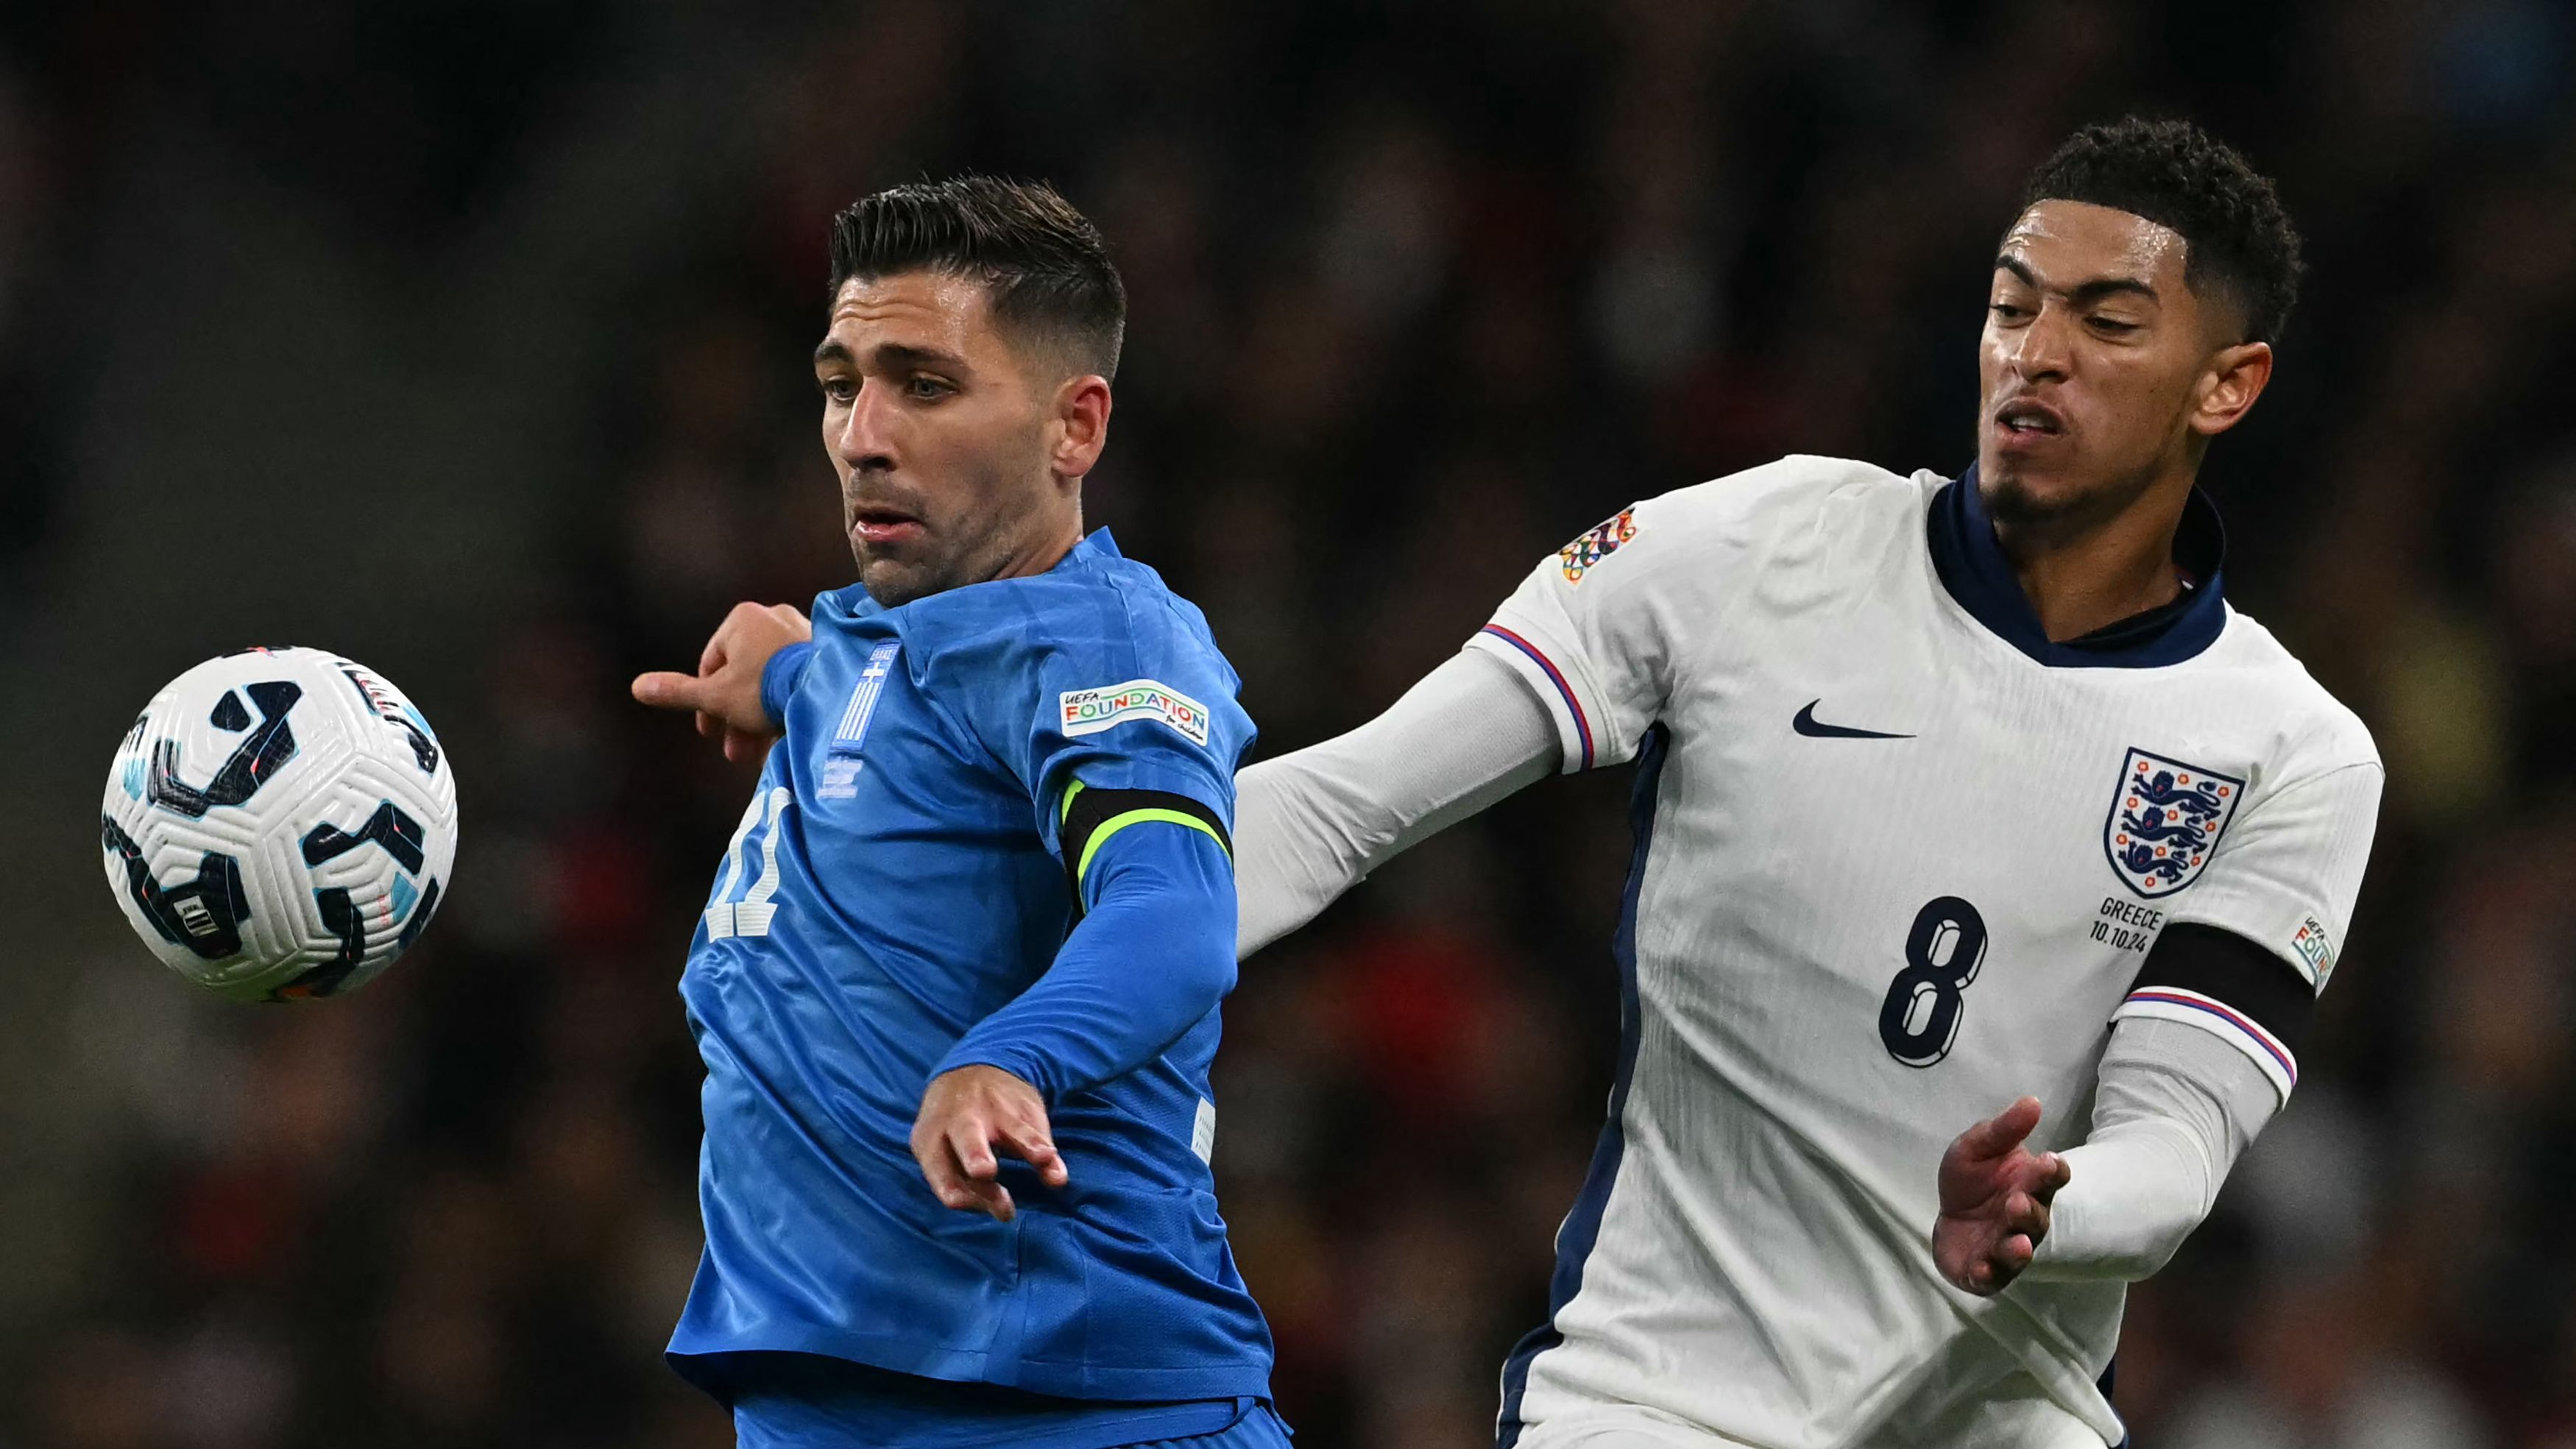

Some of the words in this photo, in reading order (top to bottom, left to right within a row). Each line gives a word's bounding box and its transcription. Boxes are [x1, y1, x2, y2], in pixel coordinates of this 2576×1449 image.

[1065, 692, 1100, 704] UEFA
[1066, 693, 1205, 731] FOUNDATION
[705, 787, 793, 943] 11
[2100, 897, 2163, 931] GREECE
[2305, 916, 2325, 942] UEFA
[2090, 921, 2148, 952] 10.10.24
[1878, 896, 1987, 1068] 8
